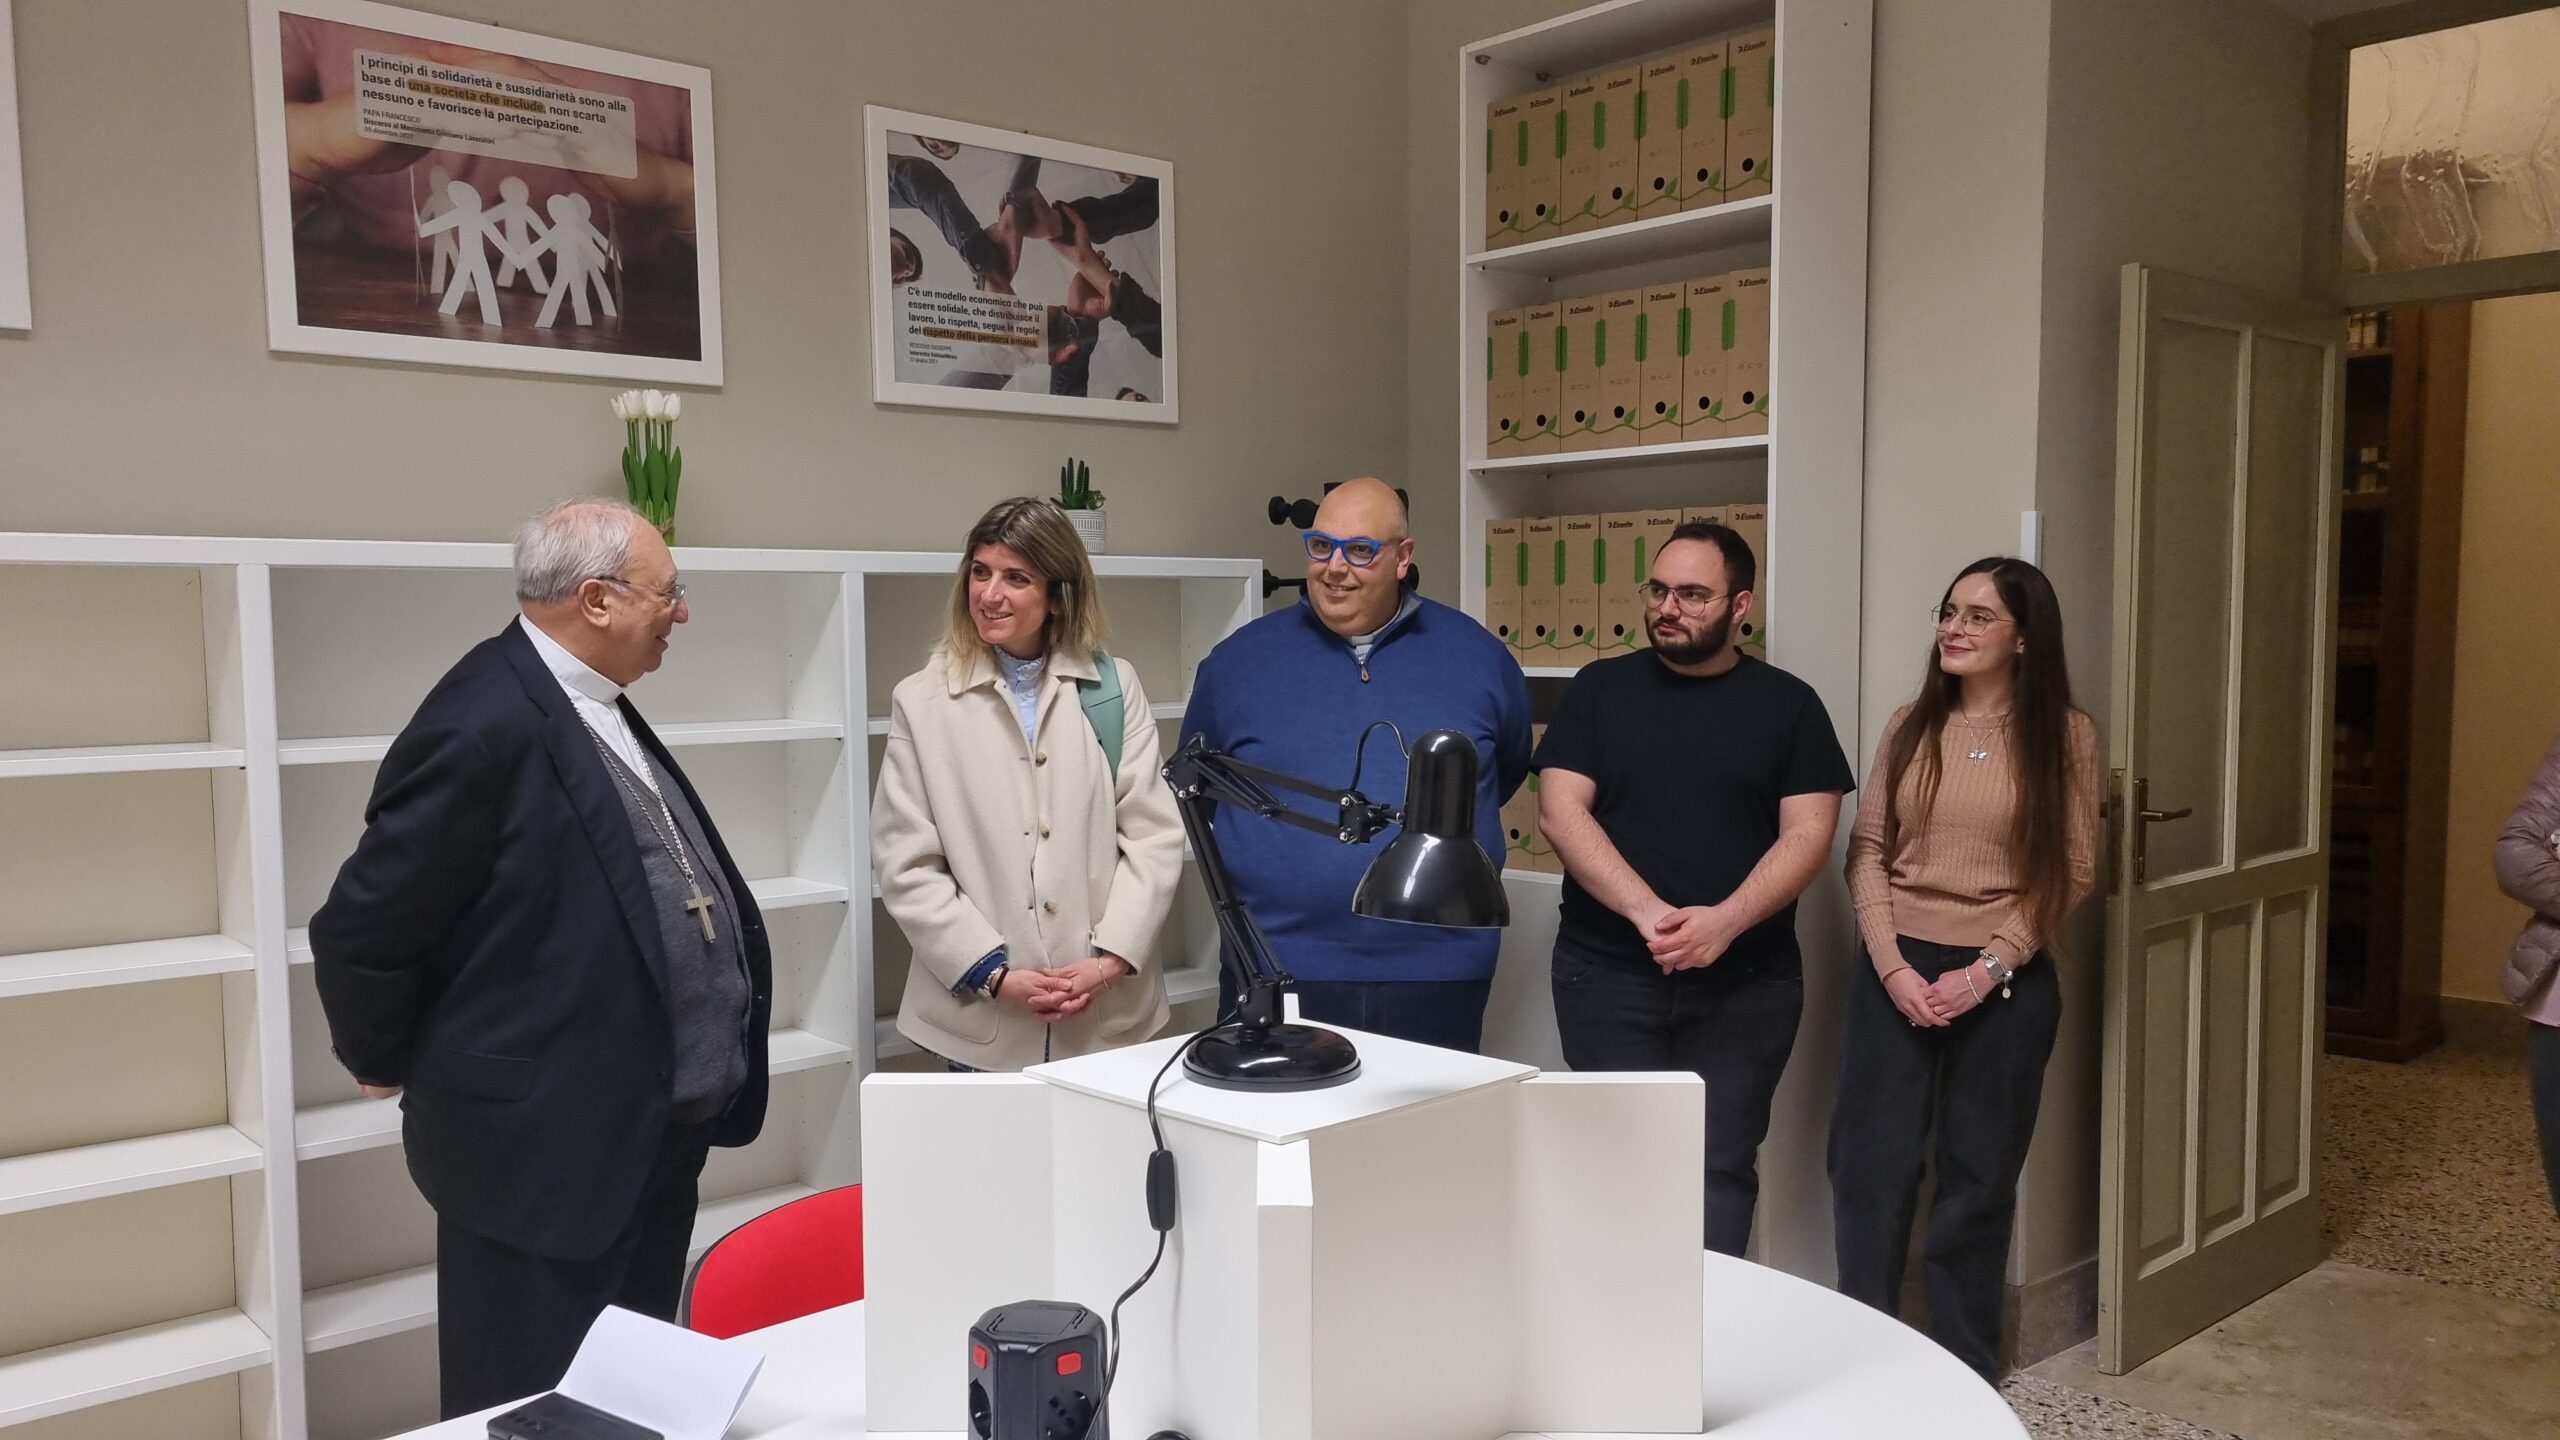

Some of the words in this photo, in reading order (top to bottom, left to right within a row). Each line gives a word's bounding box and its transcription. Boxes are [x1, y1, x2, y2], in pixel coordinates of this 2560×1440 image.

[361, 71, 391, 86] base
[394, 77, 406, 88] di
[408, 81, 431, 94] una
[434, 85, 477, 101] società
[479, 93, 500, 105] che
[502, 97, 546, 114] include,
[549, 105, 570, 117] non
[572, 110, 606, 123] scarta
[368, 58, 414, 75] principi
[417, 65, 428, 77] di
[431, 69, 493, 89] solidarietà
[495, 82, 503, 90] e
[505, 82, 576, 103] sussidiarietà
[578, 96, 605, 108] sono
[607, 100, 627, 112] alla
[362, 89, 415, 105] nessuno
[417, 99, 425, 107] e
[427, 98, 481, 117] favorisce
[484, 107, 495, 119] la
[497, 111, 582, 134] partecipazione.
[907, 286, 920, 296] C'è
[922, 290, 933, 298] un
[934, 291, 967, 302] modello
[968, 296, 1011, 307] economico
[1013, 299, 1027, 309] che
[1028, 302, 1043, 312] può
[908, 301, 935, 311] essere
[937, 303, 970, 316] solidale,
[972, 307, 987, 317] che
[988, 309, 1033, 322] distribuisce
[1034, 314, 1040, 323] il
[908, 311, 936, 325] lavoro,
[938, 315, 946, 325] lo
[947, 317, 981, 330] rispetta,
[982, 322, 1006, 333] segue
[1007, 322, 1015, 332] le
[1016, 326, 1040, 336] regole
[908, 324, 921, 335] del
[923, 328, 955, 339] rispetto
[957, 330, 976, 341] della
[977, 334, 1009, 343] persona
[1010, 338, 1039, 347] umana.
